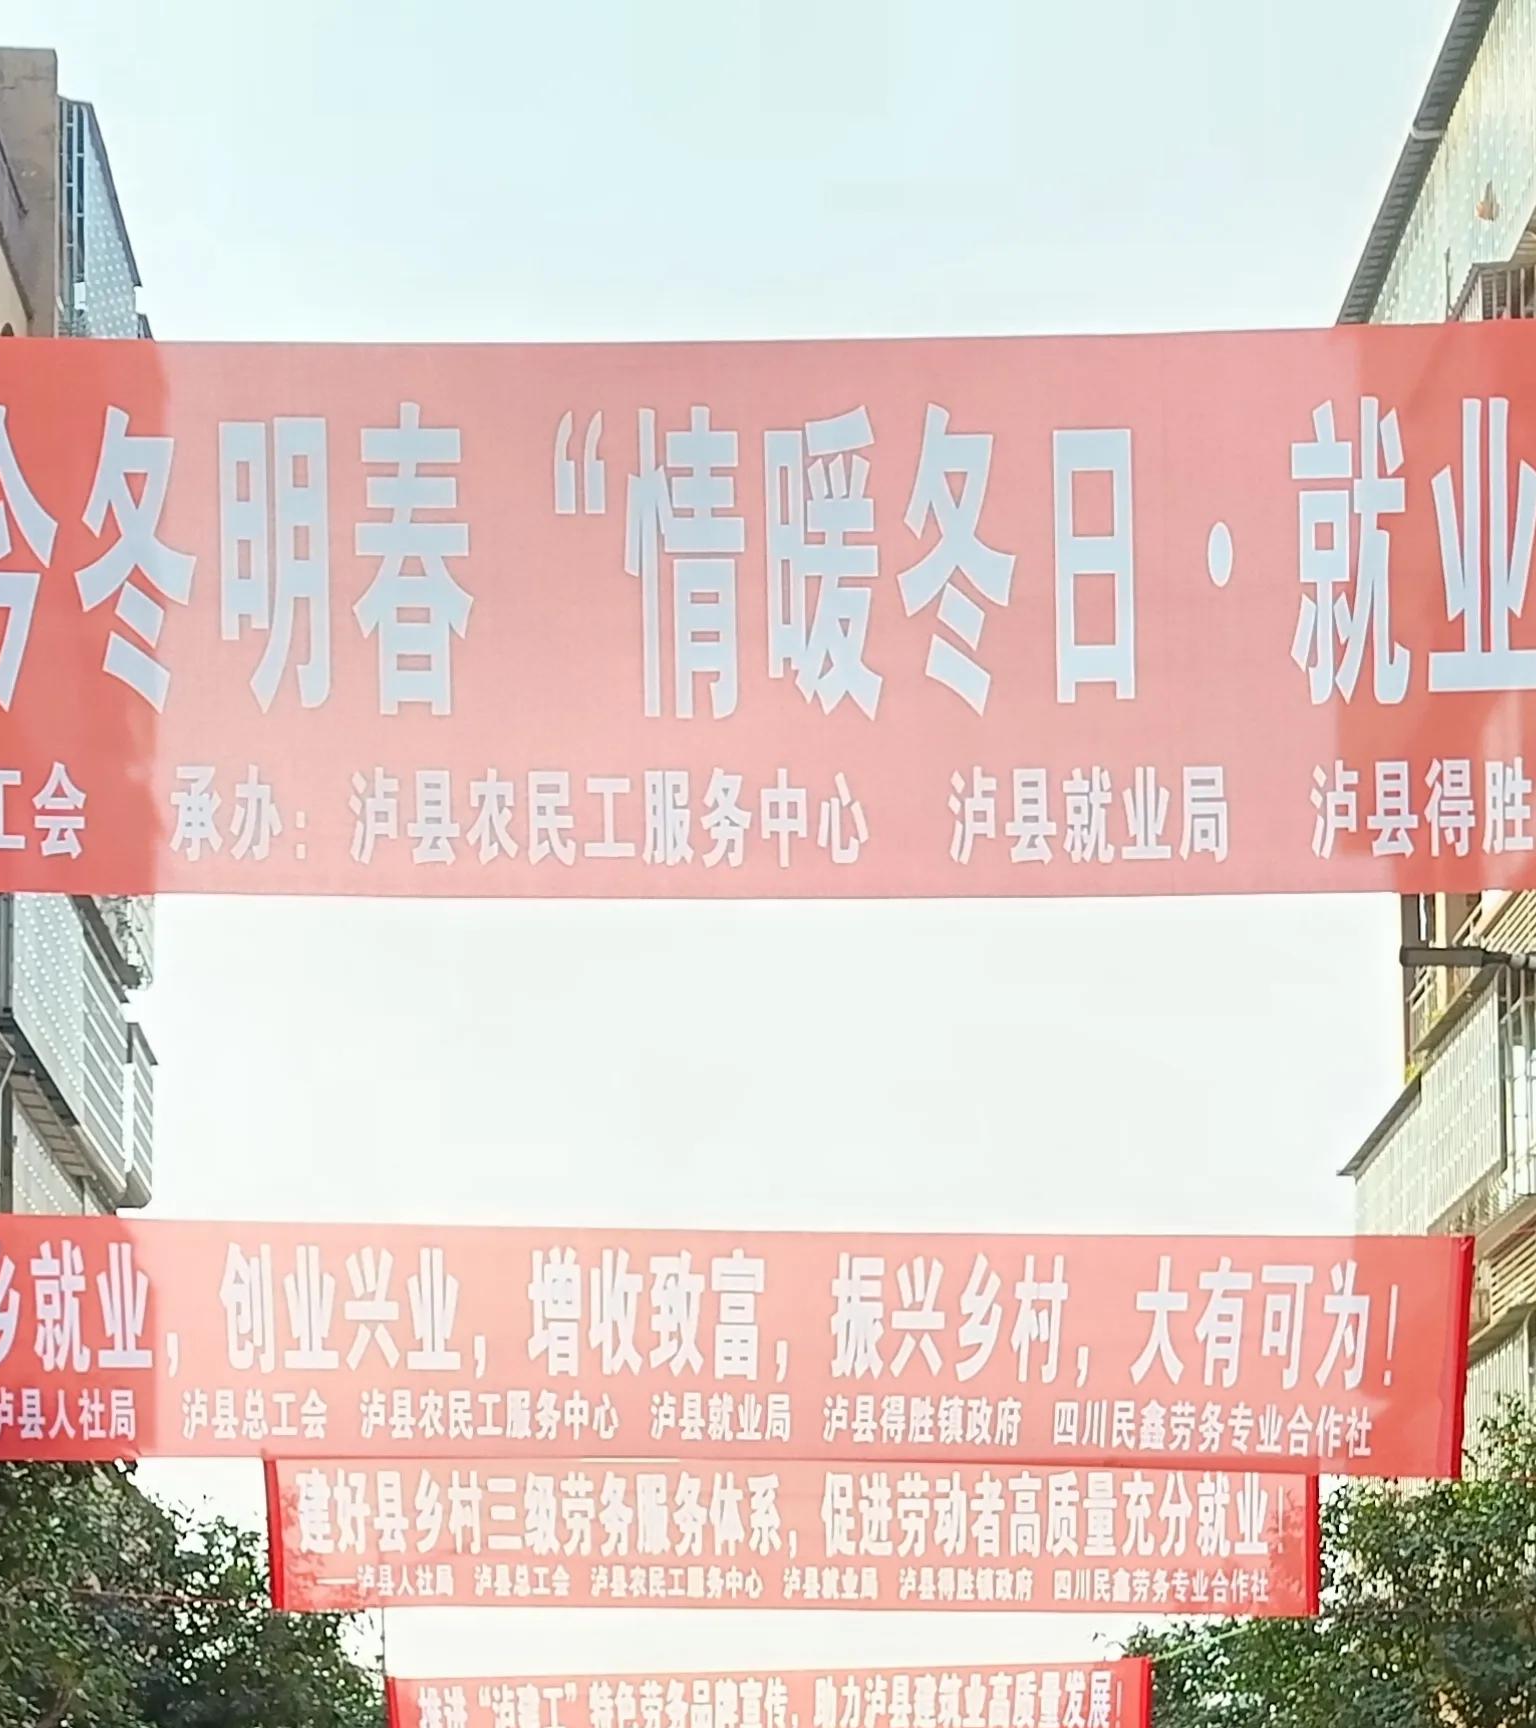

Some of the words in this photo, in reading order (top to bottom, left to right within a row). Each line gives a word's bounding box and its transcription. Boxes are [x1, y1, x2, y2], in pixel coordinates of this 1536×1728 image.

[948, 766, 1229, 865] 泸县就业局
[182, 1388, 328, 1442] 泸县总工会
[360, 1388, 621, 1442] 泸县农民工服务中心
[649, 1392, 791, 1444] 泸县就业局
[823, 1394, 1023, 1448] 泸县得胜镇政府
[1053, 1401, 1373, 1459] 四川民鑫劳务专业合作社
